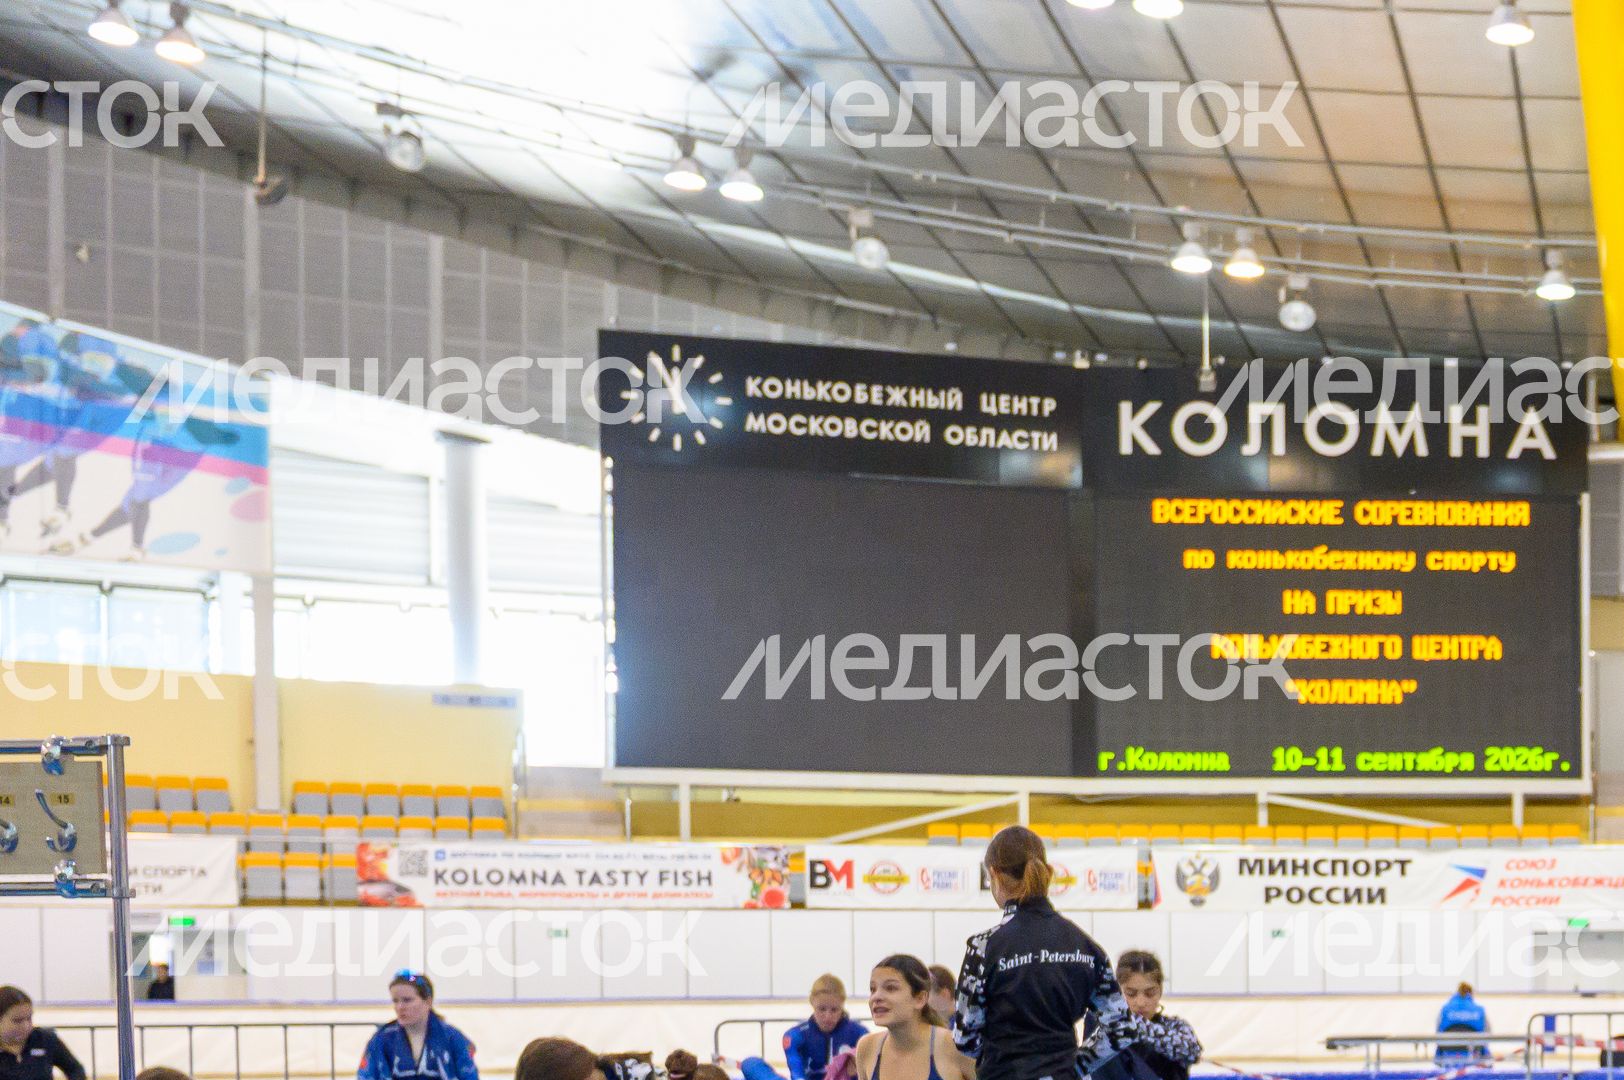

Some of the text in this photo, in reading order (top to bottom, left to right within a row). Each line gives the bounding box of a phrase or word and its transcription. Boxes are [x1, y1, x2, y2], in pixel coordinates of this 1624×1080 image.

[746, 375, 1058, 418] КОНЬКОБЕЖНЫЙ ЦЕНТР
[745, 411, 1059, 452] МОСКОВСКОЙ ОБЛАСТИ
[1118, 400, 1557, 460] КОЛОМНА
[1355, 501, 1531, 527] СОРЕВНОВАНИЯ
[1183, 545, 1516, 573] по конькобежному спорту
[1282, 590, 1403, 616] НА ПРИЗЫ
[1210, 635, 1503, 662] КОНЬКОБЕЖНОГО ЦЕНТРА
[1285, 679, 1418, 705] "КОЛОМНА"
[1271, 747, 1345, 773] 10-11
[1356, 748, 1475, 774] сентября
[58, 795, 70, 804] 15
[142, 865, 207, 877] СПОРТА
[1238, 858, 1413, 878] МИНСПОРТ
[1505, 858, 1557, 871] СОЮЗ
[434, 869, 713, 887] KOLOMNA TASTY FISH
[1264, 886, 1388, 905] РОССИИ
[1491, 894, 1561, 908] РОССИИ
[998, 949, 1096, 973] Saint-Petersburg
